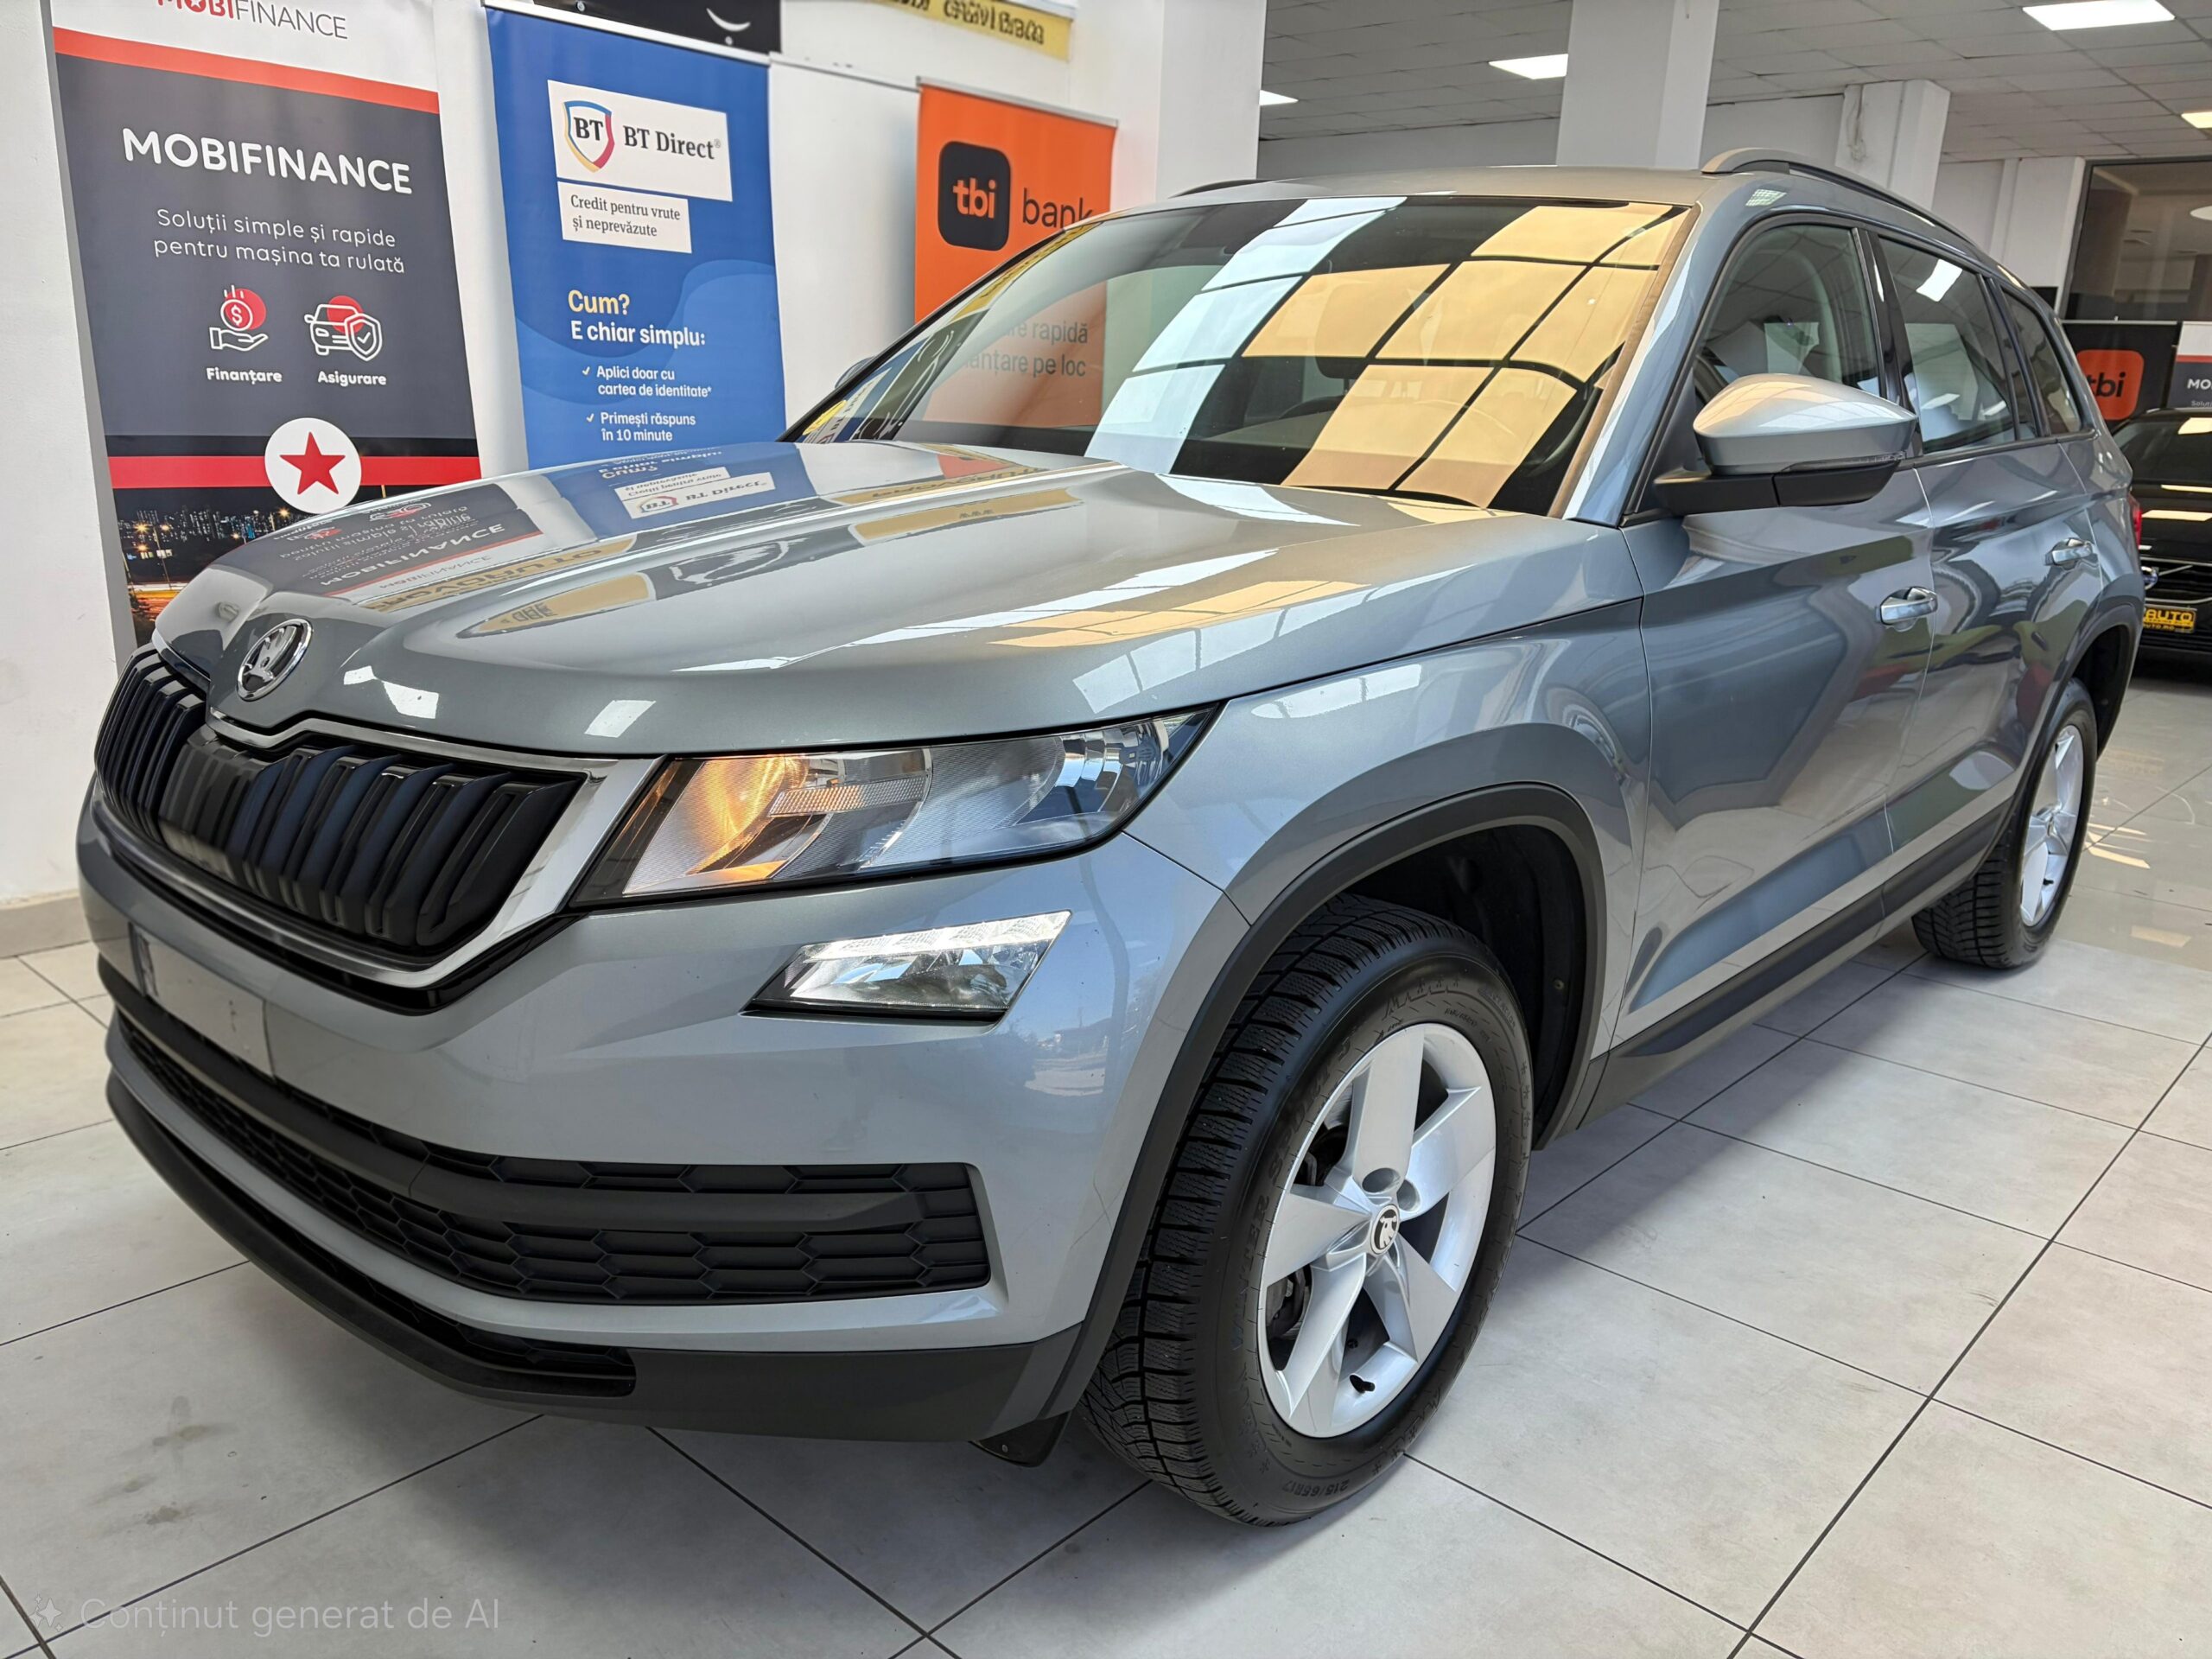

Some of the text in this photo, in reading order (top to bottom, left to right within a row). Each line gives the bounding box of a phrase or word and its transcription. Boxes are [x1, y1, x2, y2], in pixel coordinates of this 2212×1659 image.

[573, 117, 604, 141] BT
[623, 125, 650, 149] BT
[122, 128, 413, 194] MOBIFINANCE
[570, 194, 681, 220] Credit pentru vrute
[952, 178, 996, 219] tbi
[156, 209, 397, 248] Soluții simple și rapide
[572, 215, 658, 237] și neprevăzute
[154, 238, 404, 274] pentru mașina ta rulată
[568, 289, 631, 315] Cum?
[570, 321, 706, 349] E chiar simplu:
[1033, 321, 1089, 345] rapidă
[206, 366, 283, 385] Finanțare
[596, 365, 675, 380] Aplici doar cu
[1033, 357, 1057, 378] pe
[1061, 354, 1086, 377] loc
[317, 371, 387, 387] Asigurare
[598, 383, 636, 396] cartea
[638, 383, 653, 397] de
[601, 411, 696, 428] Primești răspuns
[601, 429, 673, 442] în 10 minute
[2143, 608, 2193, 622] AUTO
